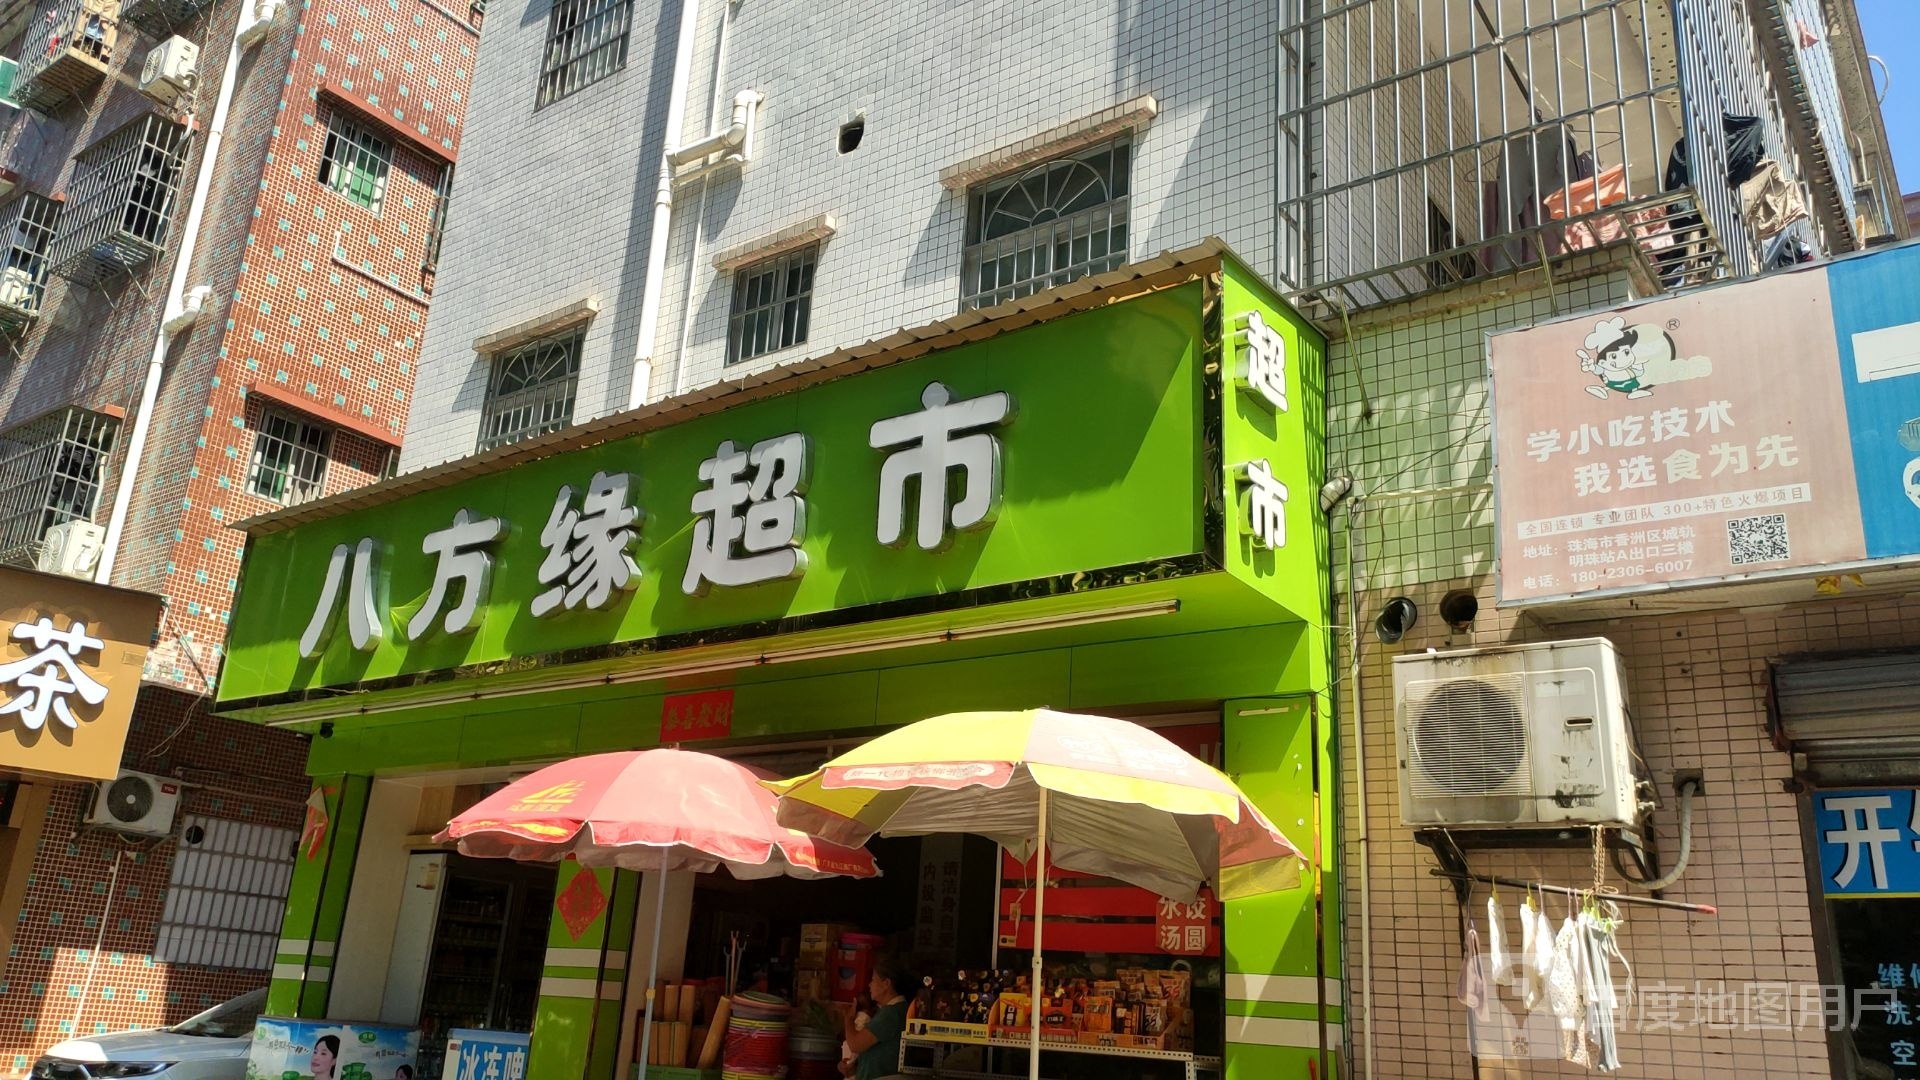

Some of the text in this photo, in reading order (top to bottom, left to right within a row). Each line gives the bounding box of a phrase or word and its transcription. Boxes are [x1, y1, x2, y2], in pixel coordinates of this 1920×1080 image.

[1248, 310, 1289, 550] 超市
[1526, 399, 1736, 463] 学小吃技术
[1573, 434, 1800, 497] 我选食为先
[300, 381, 1014, 659] 八方缘超市
[1525, 486, 1804, 536] 全国连锁 专业团队 300+特色火爆项目
[1567, 525, 1696, 553] 珠海市香洲区城轨
[1568, 540, 1695, 568] 明珠站A出口三楼
[1570, 559, 1694, 584] 180-2306-6007
[0, 617, 109, 730] 茶
[1823, 788, 1920, 890] 开
[1160, 924, 1206, 951] 汤圆
